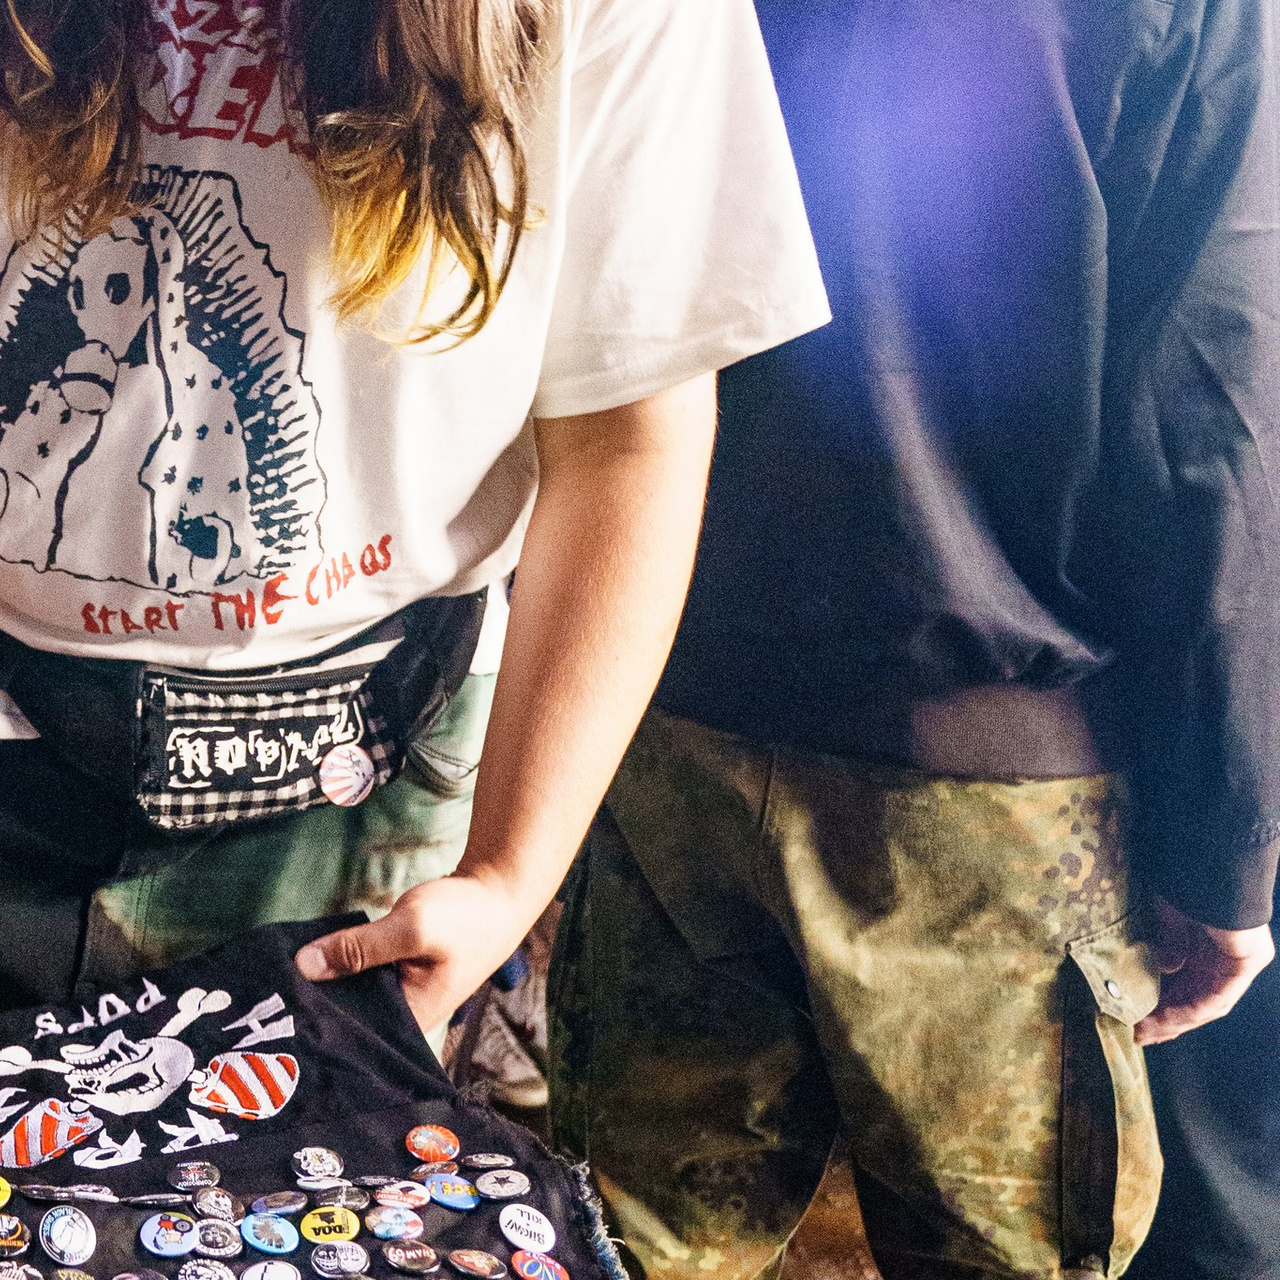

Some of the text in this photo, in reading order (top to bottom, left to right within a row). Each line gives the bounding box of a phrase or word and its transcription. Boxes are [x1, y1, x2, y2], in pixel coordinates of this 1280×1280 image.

[81, 534, 392, 634] START THE CHAOS
[516, 1208, 542, 1224] KILL
[504, 1219, 545, 1245] BIKINI
[387, 1247, 437, 1260] SHAM 69
